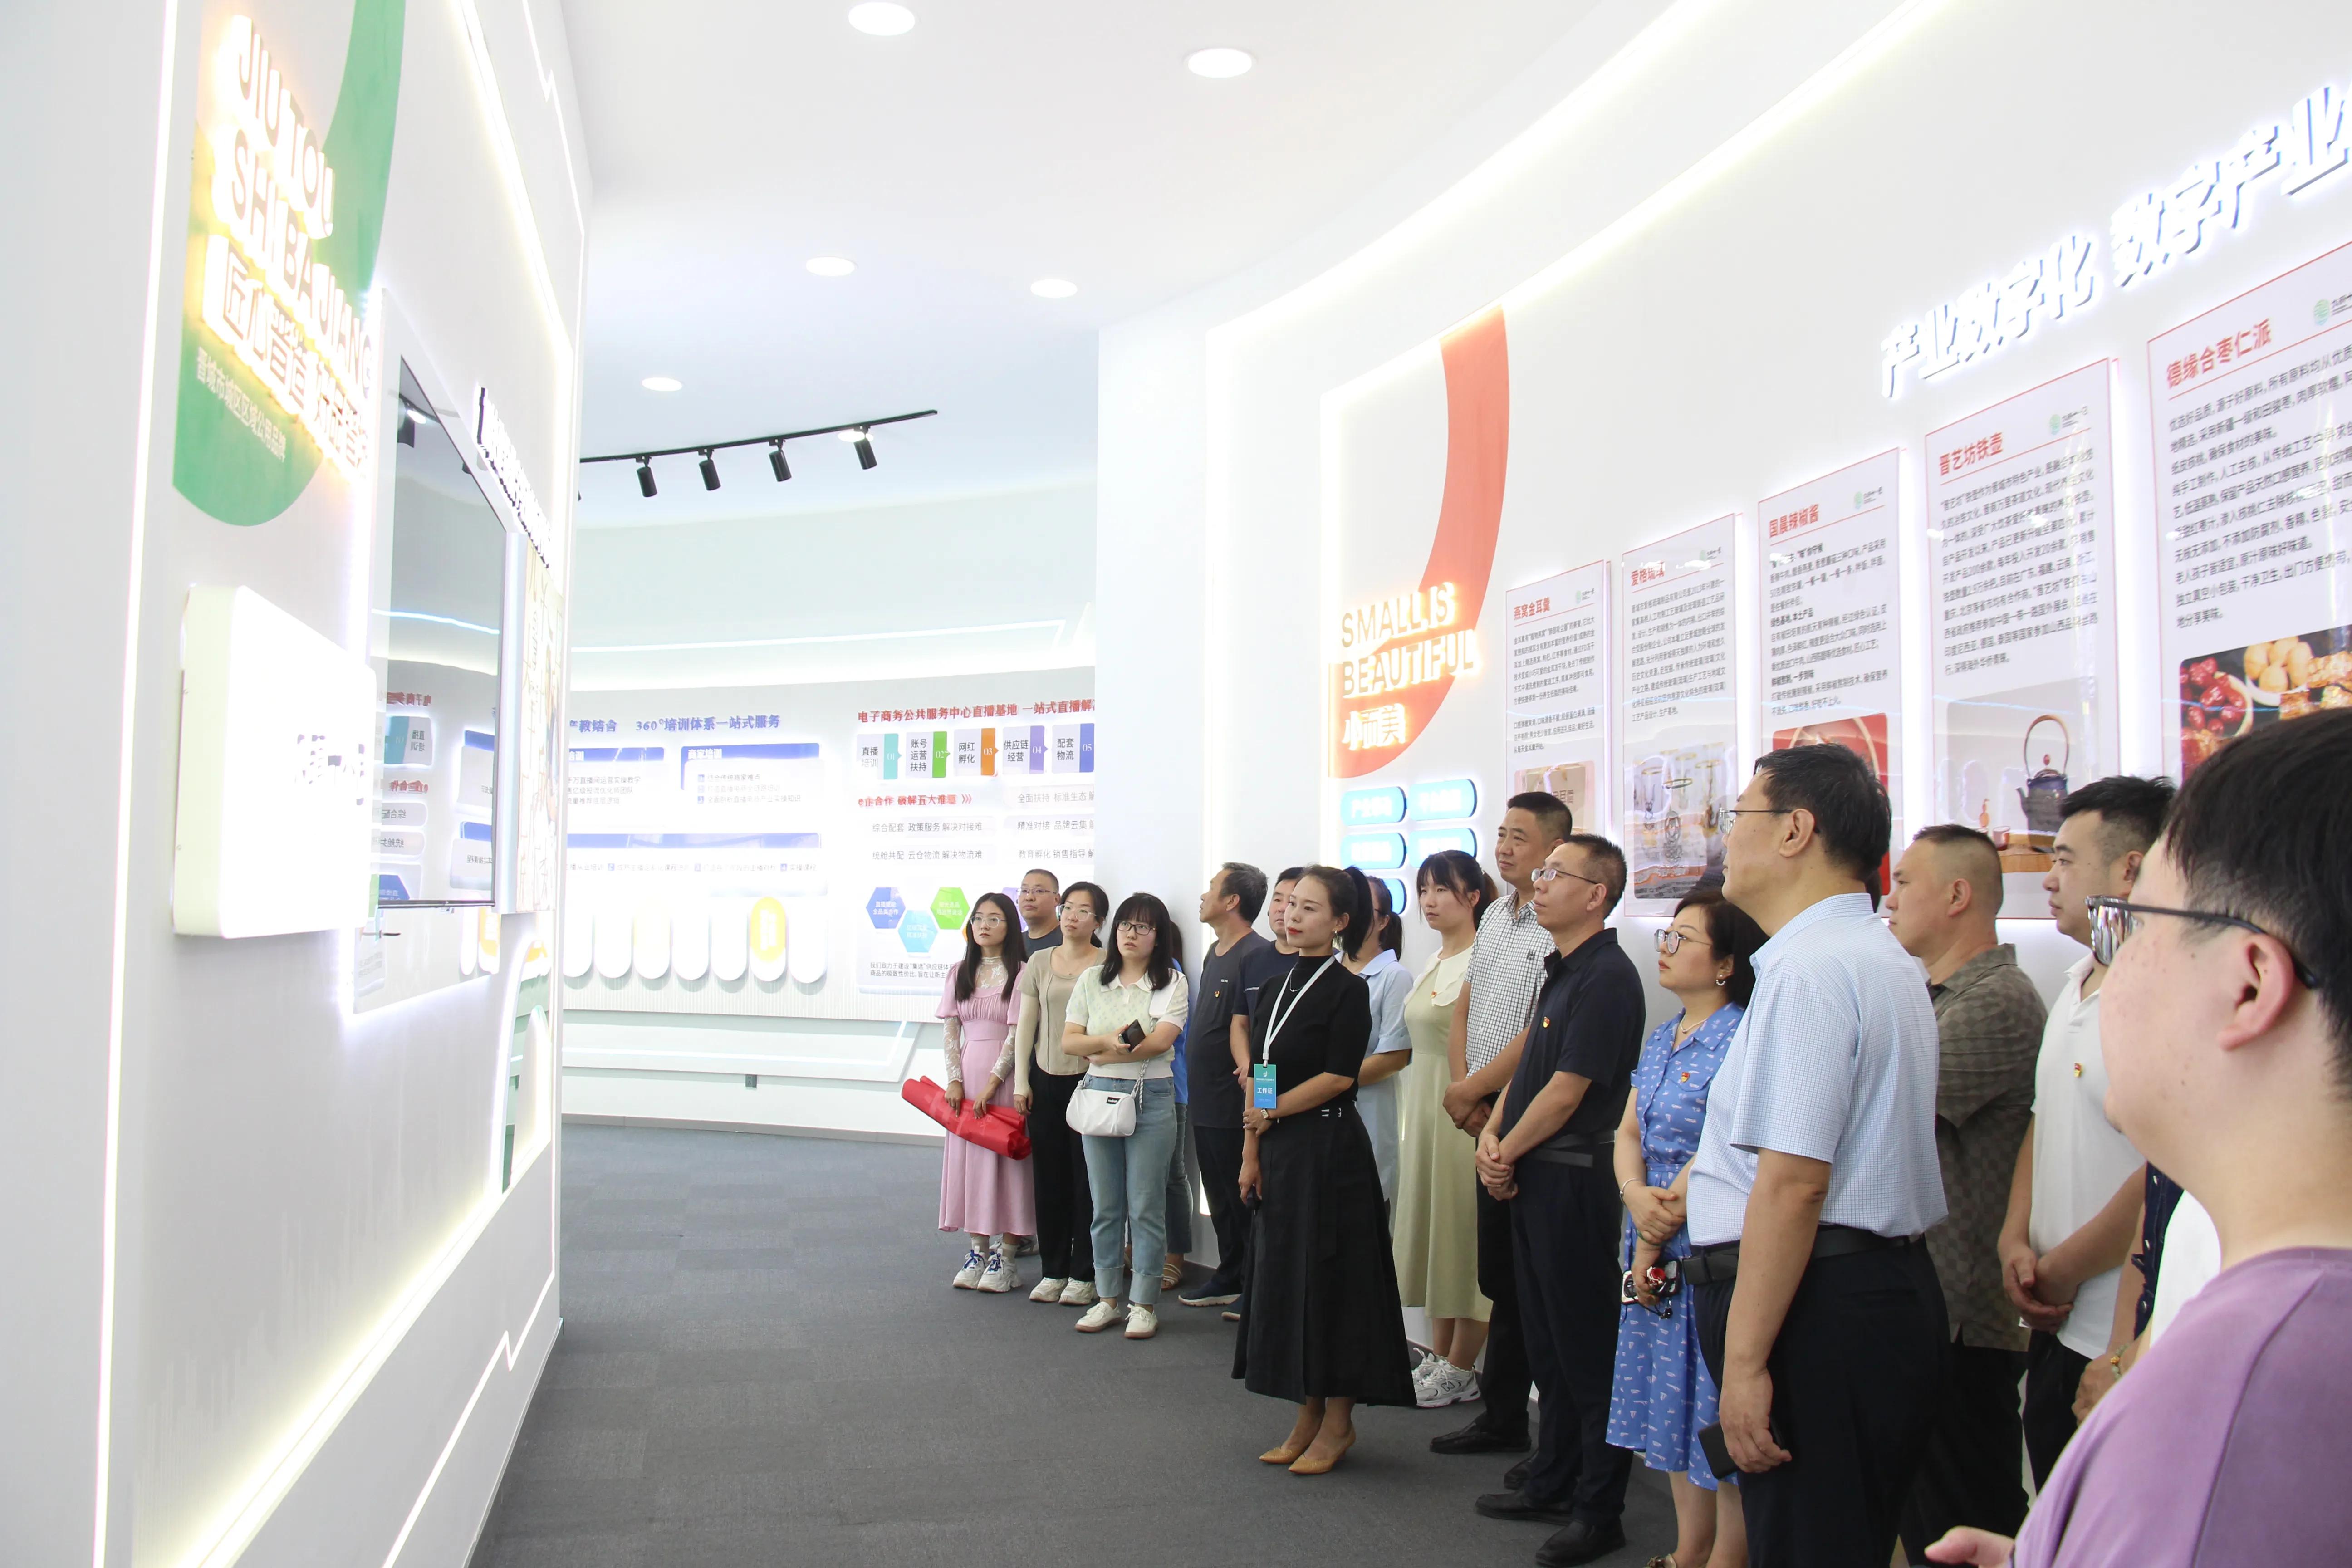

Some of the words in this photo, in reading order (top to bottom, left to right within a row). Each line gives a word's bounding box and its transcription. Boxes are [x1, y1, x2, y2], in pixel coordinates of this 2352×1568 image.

[1881, 234, 2094, 398] 产业数字化
[2167, 318, 2271, 388] 德缘合枣仁派
[1940, 432, 2003, 476] 晋艺坊铁壶
[1342, 592, 1425, 648] SMALL
[1429, 583, 1454, 627] IS
[1342, 629, 1475, 697] BEAUTIFUL
[858, 704, 1018, 723] 电子商务公共服务中心直播基地
[911, 739, 927, 748] 账号
[958, 742, 975, 751] 网红
[1004, 740, 1029, 750] 供应链
[1057, 739, 1074, 748] 配套
[862, 747, 878, 756] 直播
[911, 751, 927, 760] 运营
[1057, 751, 1074, 760] 物流
[958, 755, 975, 764] 孵化
[1007, 753, 1024, 762] 经营
[910, 763, 927, 772] 扶持
[858, 796, 895, 807] e企合作
[897, 794, 956, 805] 破解五大难题
[872, 823, 904, 833] 综合配套
[908, 823, 940, 832] 政策服务
[1017, 821, 1050, 831] 精准对接
[1054, 820, 1088, 831] 品牌云集
[908, 851, 940, 860] 云仓物流
[942, 850, 982, 860] 解决物流难
[1053, 849, 1086, 859] 销售指导
[870, 970, 946, 978] 商品的极致性价比，旨在让新主
